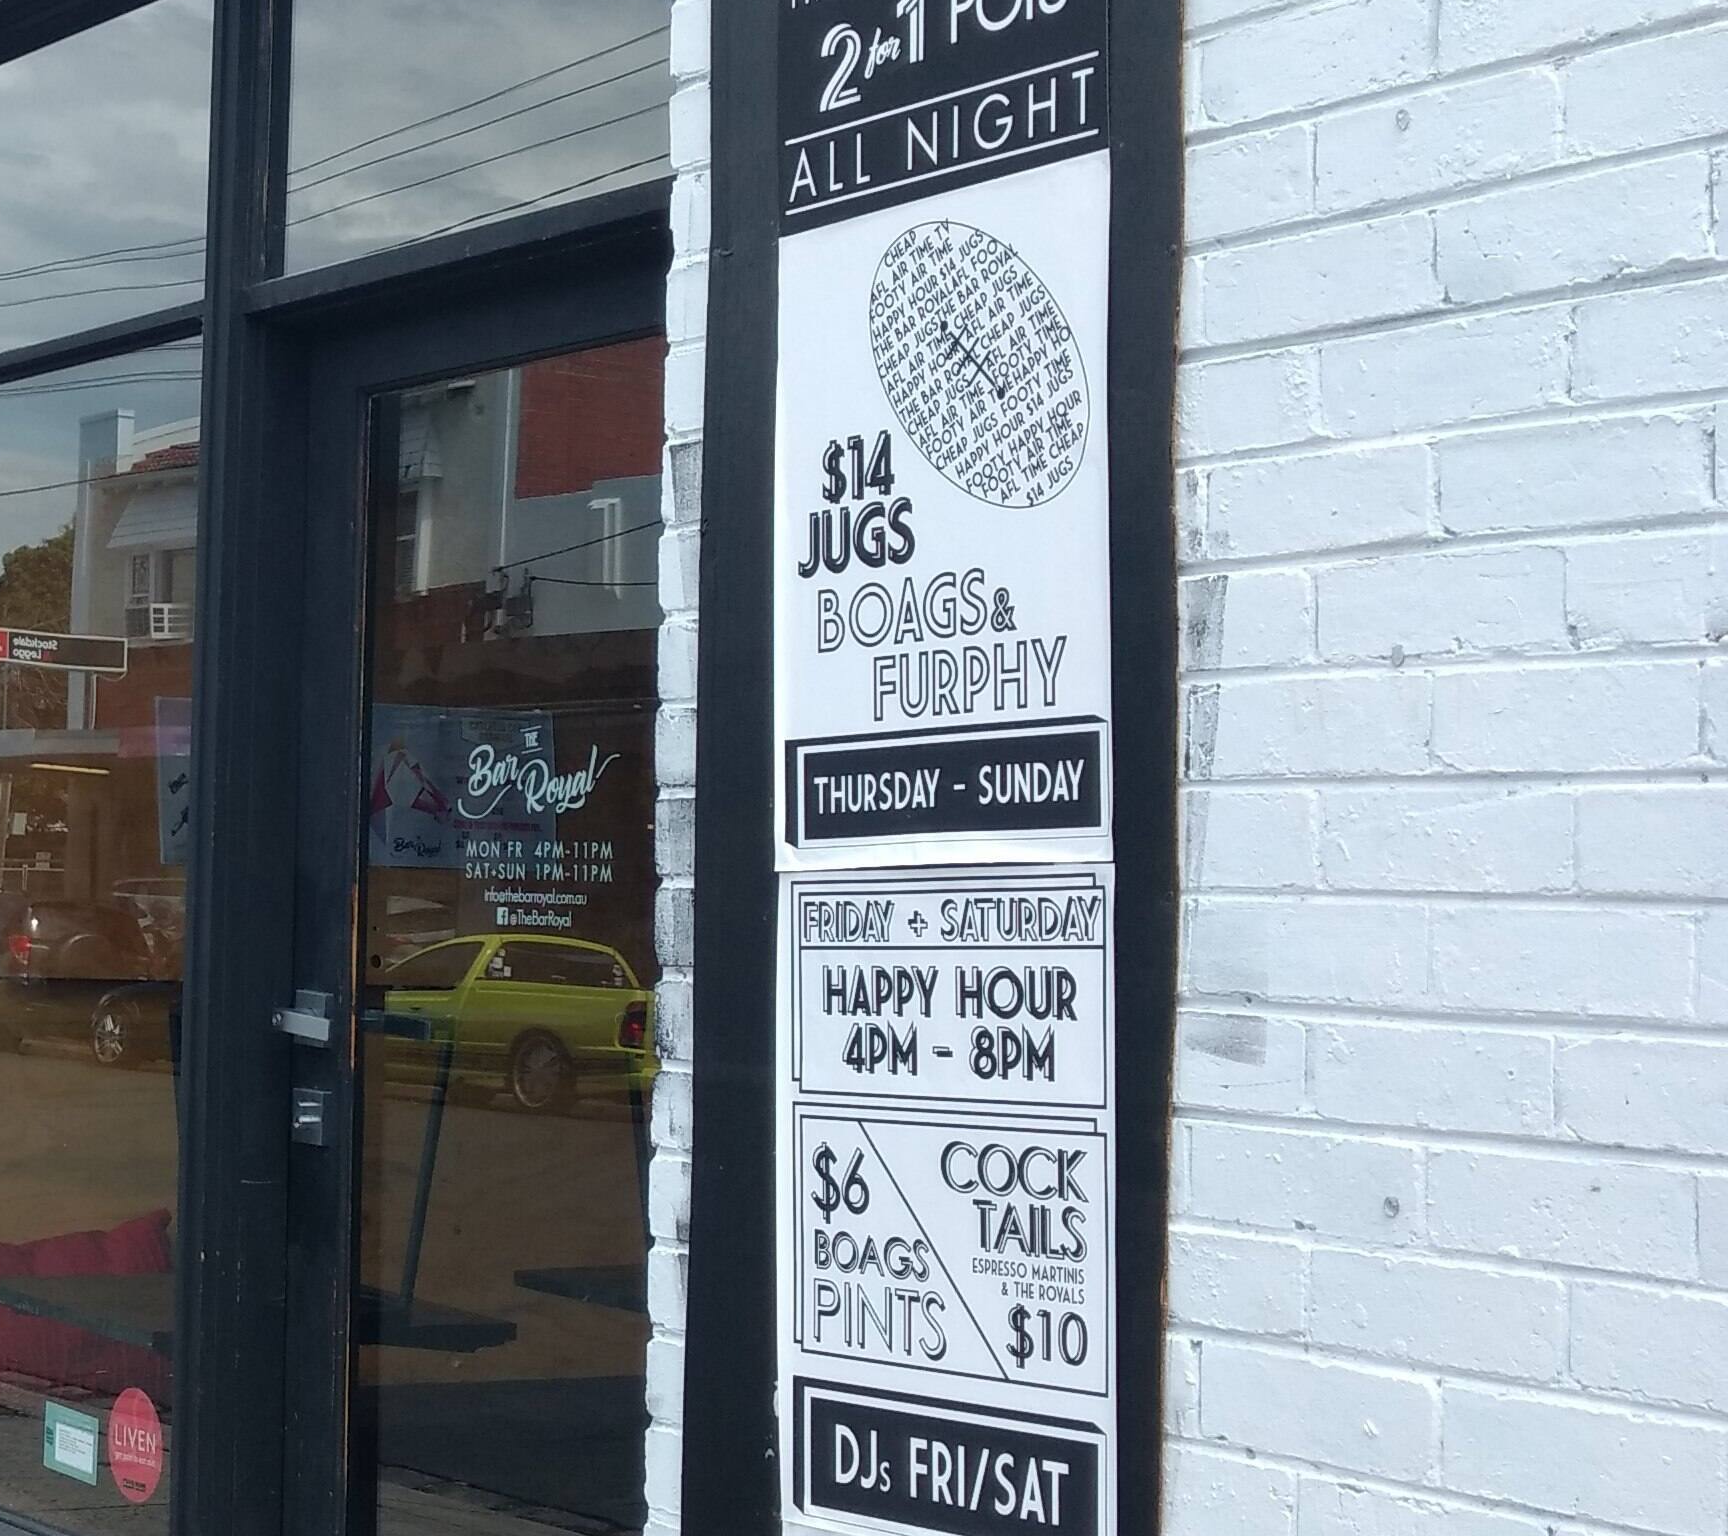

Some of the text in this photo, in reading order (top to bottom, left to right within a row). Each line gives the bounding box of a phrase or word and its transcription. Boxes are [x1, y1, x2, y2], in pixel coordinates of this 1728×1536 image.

[788, 67, 1096, 203] ALL NIGHT
[884, 231, 916, 268] CHEAP
[909, 236, 934, 264] TIME
[957, 243, 1018, 305] BAR ROYAL
[872, 229, 984, 342] HAPPY HOUR JUGS
[954, 266, 1018, 329] CHEAP JUGS
[1006, 271, 1034, 301] TIME
[981, 285, 1045, 349] CHEAP JUGS
[936, 373, 1041, 471] CHEAP JUGS FOOTY
[955, 368, 1072, 479] HAPPY HOUR JUGS
[1047, 390, 1082, 424] HOUR
[822, 430, 895, 504] $14
[1021, 422, 1084, 482] TIME CHEAP
[1047, 455, 1073, 489] JUGS
[798, 496, 916, 579] JUGS
[873, 635, 1066, 722] FURPHY
[468, 744, 613, 814] Bar Royal
[813, 759, 1085, 815] THURSDAY SUNDAY
[466, 840, 500, 858] MON
[534, 841, 613, 859] 4PM-11PM
[536, 864, 613, 882] 1PM-11PM
[484, 886, 587, 907] info@thebarroyal.com.au
[802, 897, 895, 944] FRIDAY
[940, 893, 1102, 943] SATURDAY
[821, 964, 1077, 1021] HAPPY HOUR
[841, 1022, 1055, 1081] 4PM 8PM
[811, 1142, 870, 1223] $6
[940, 1140, 1089, 1202] COCK
[814, 1229, 931, 1282] BOAGS
[972, 1198, 1088, 1263] TAILS
[972, 1258, 1085, 1284] ESPRESSO MARTINIS
[1014, 1283, 1034, 1300] THE
[1038, 1286, 1085, 1305] ROYALS
[813, 1279, 948, 1362] PINTS
[1006, 1304, 1088, 1368] $10
[115, 1424, 156, 1454] LIVEN
[834, 1423, 1069, 1527] DJs FRI/SAT
